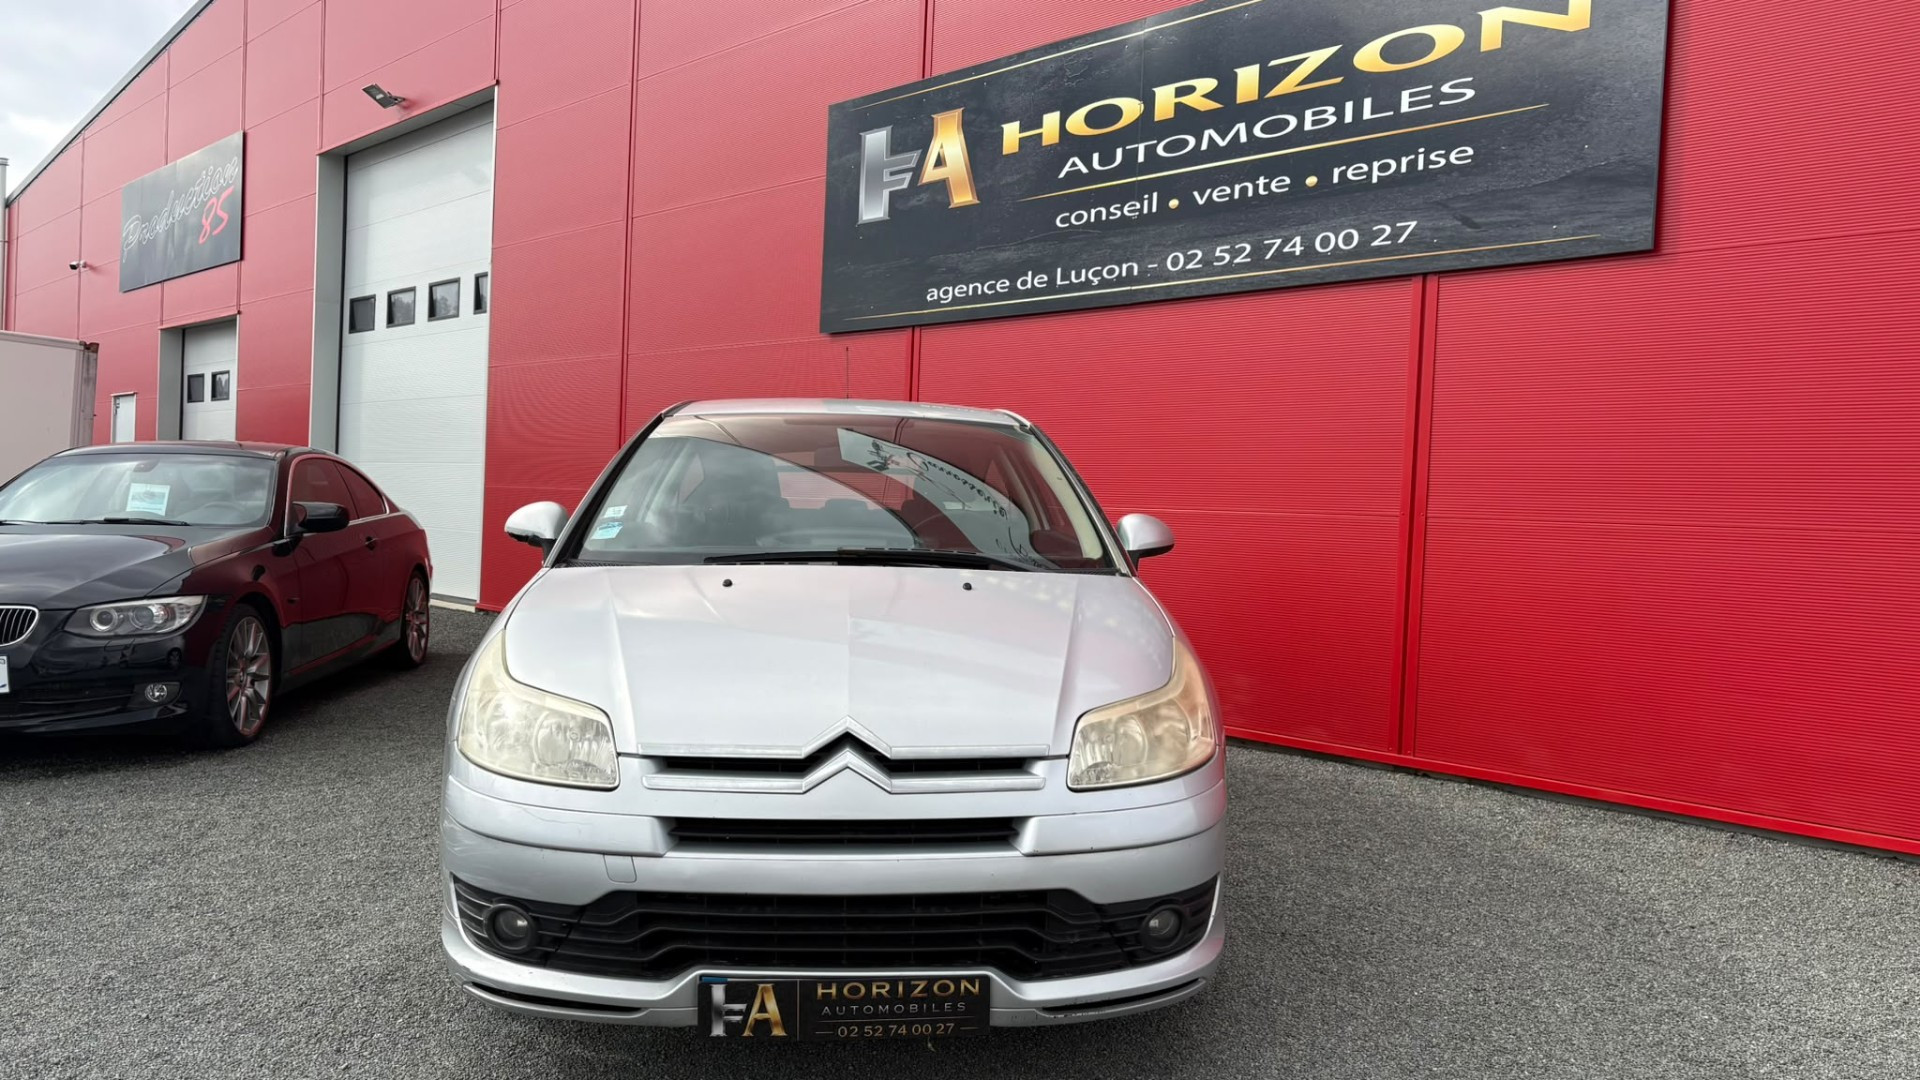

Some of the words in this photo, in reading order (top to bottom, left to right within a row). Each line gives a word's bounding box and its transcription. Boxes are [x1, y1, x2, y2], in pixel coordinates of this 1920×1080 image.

[1001, 0, 1592, 156] HORIZON
[1058, 77, 1476, 179] AUTOMOBILES
[122, 156, 239, 264] Production
[199, 186, 234, 245] 85
[1055, 191, 1158, 228] conseil
[1192, 175, 1291, 206] vente
[1332, 145, 1474, 184] reprise
[926, 277, 1010, 304] agence
[1016, 270, 1049, 290] de
[1056, 261, 1139, 286] Luçon
[1166, 249, 1203, 271] 02
[1213, 243, 1252, 266] 52
[1263, 235, 1305, 260] 74
[1314, 228, 1360, 253] 00
[1370, 220, 1418, 247] 27
[816, 978, 981, 1000] HORIZON
[821, 1001, 967, 1016] AUTOMOBILES
[837, 1025, 859, 1038] 02
[863, 1025, 884, 1037] 52
[888, 1024, 909, 1037] 74
[911, 1023, 932, 1036] 00
[935, 1022, 955, 1035] 27
